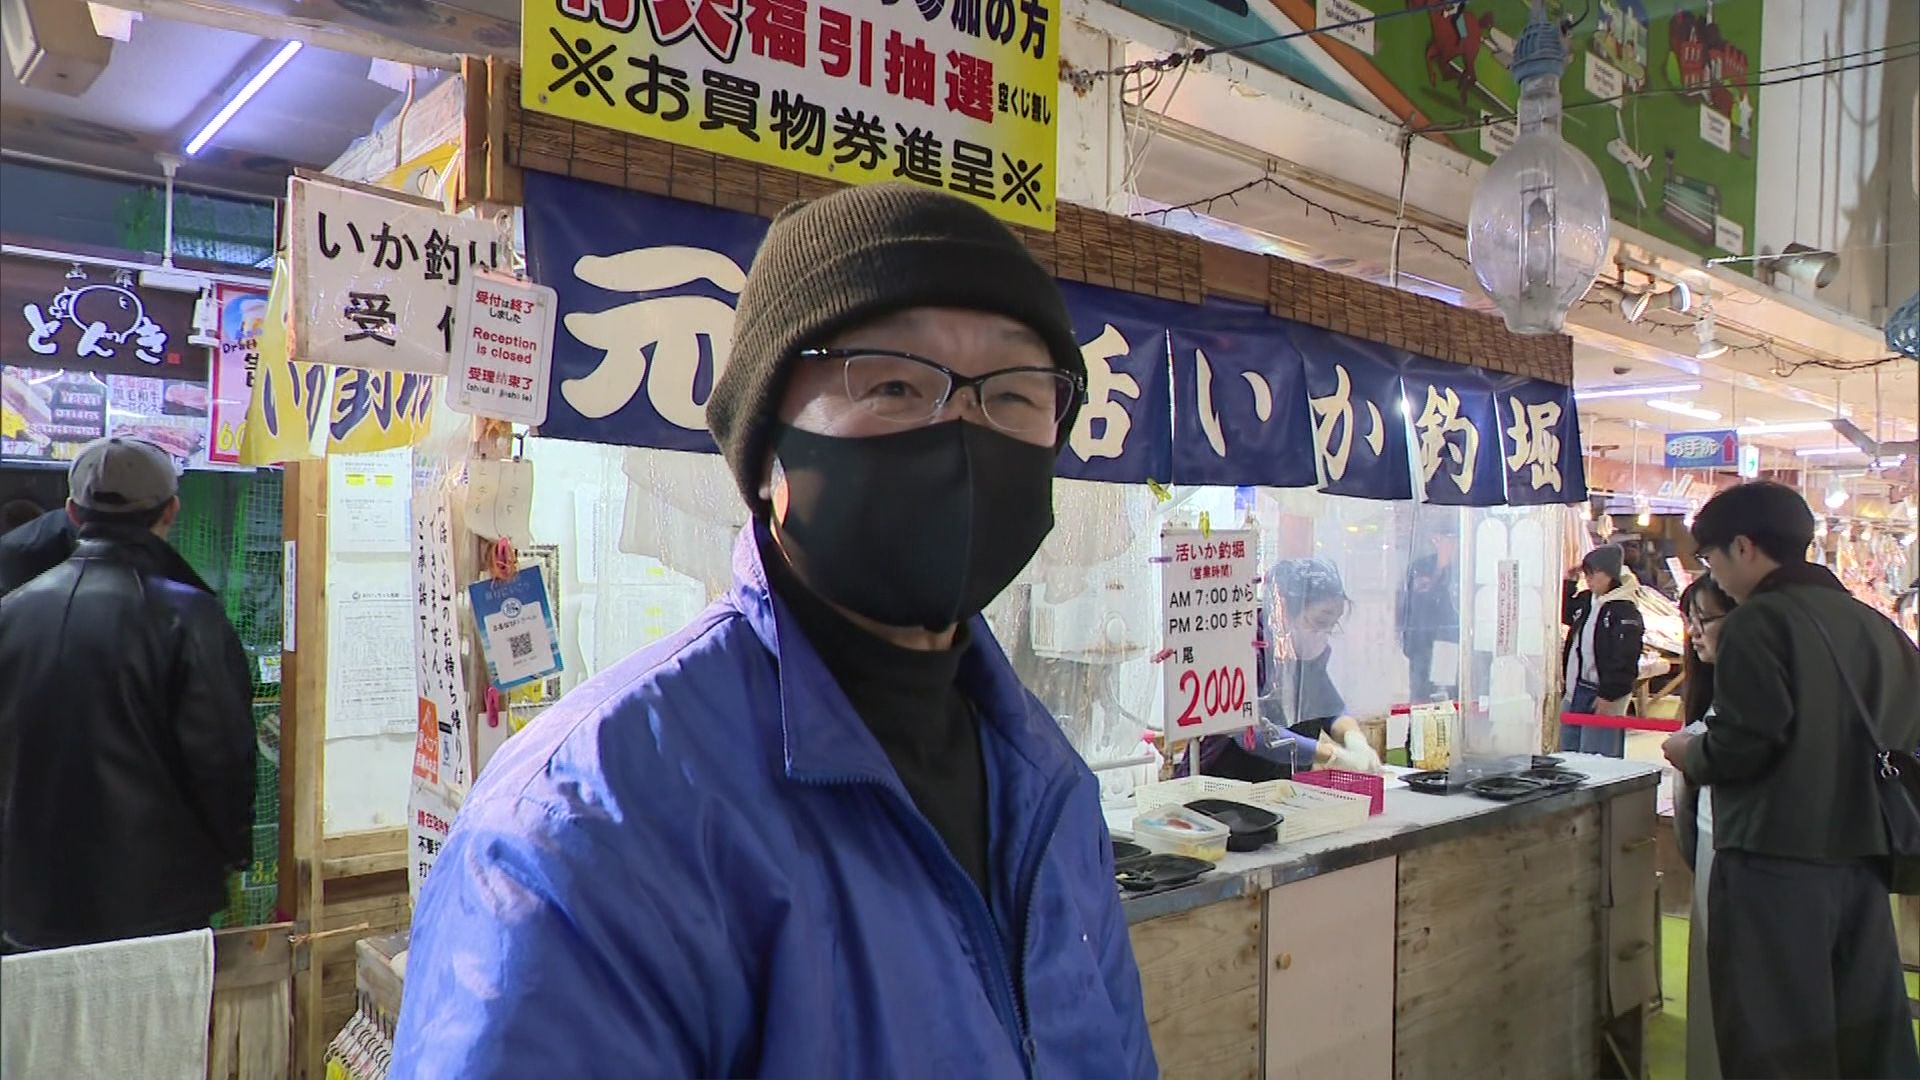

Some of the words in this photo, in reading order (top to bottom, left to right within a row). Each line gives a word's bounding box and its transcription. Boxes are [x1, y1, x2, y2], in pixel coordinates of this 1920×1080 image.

[472, 326, 537, 352] Reception
[476, 344, 487, 355] is
[491, 347, 532, 364] closed
[1176, 540, 1245, 562] 活いか釣堀
[1169, 590, 1191, 608] AM
[1195, 588, 1228, 605] 7:00
[1232, 585, 1254, 602] から
[1169, 618, 1191, 634] PM
[1195, 613, 1228, 631] 2:00
[1232, 610, 1254, 629] まで
